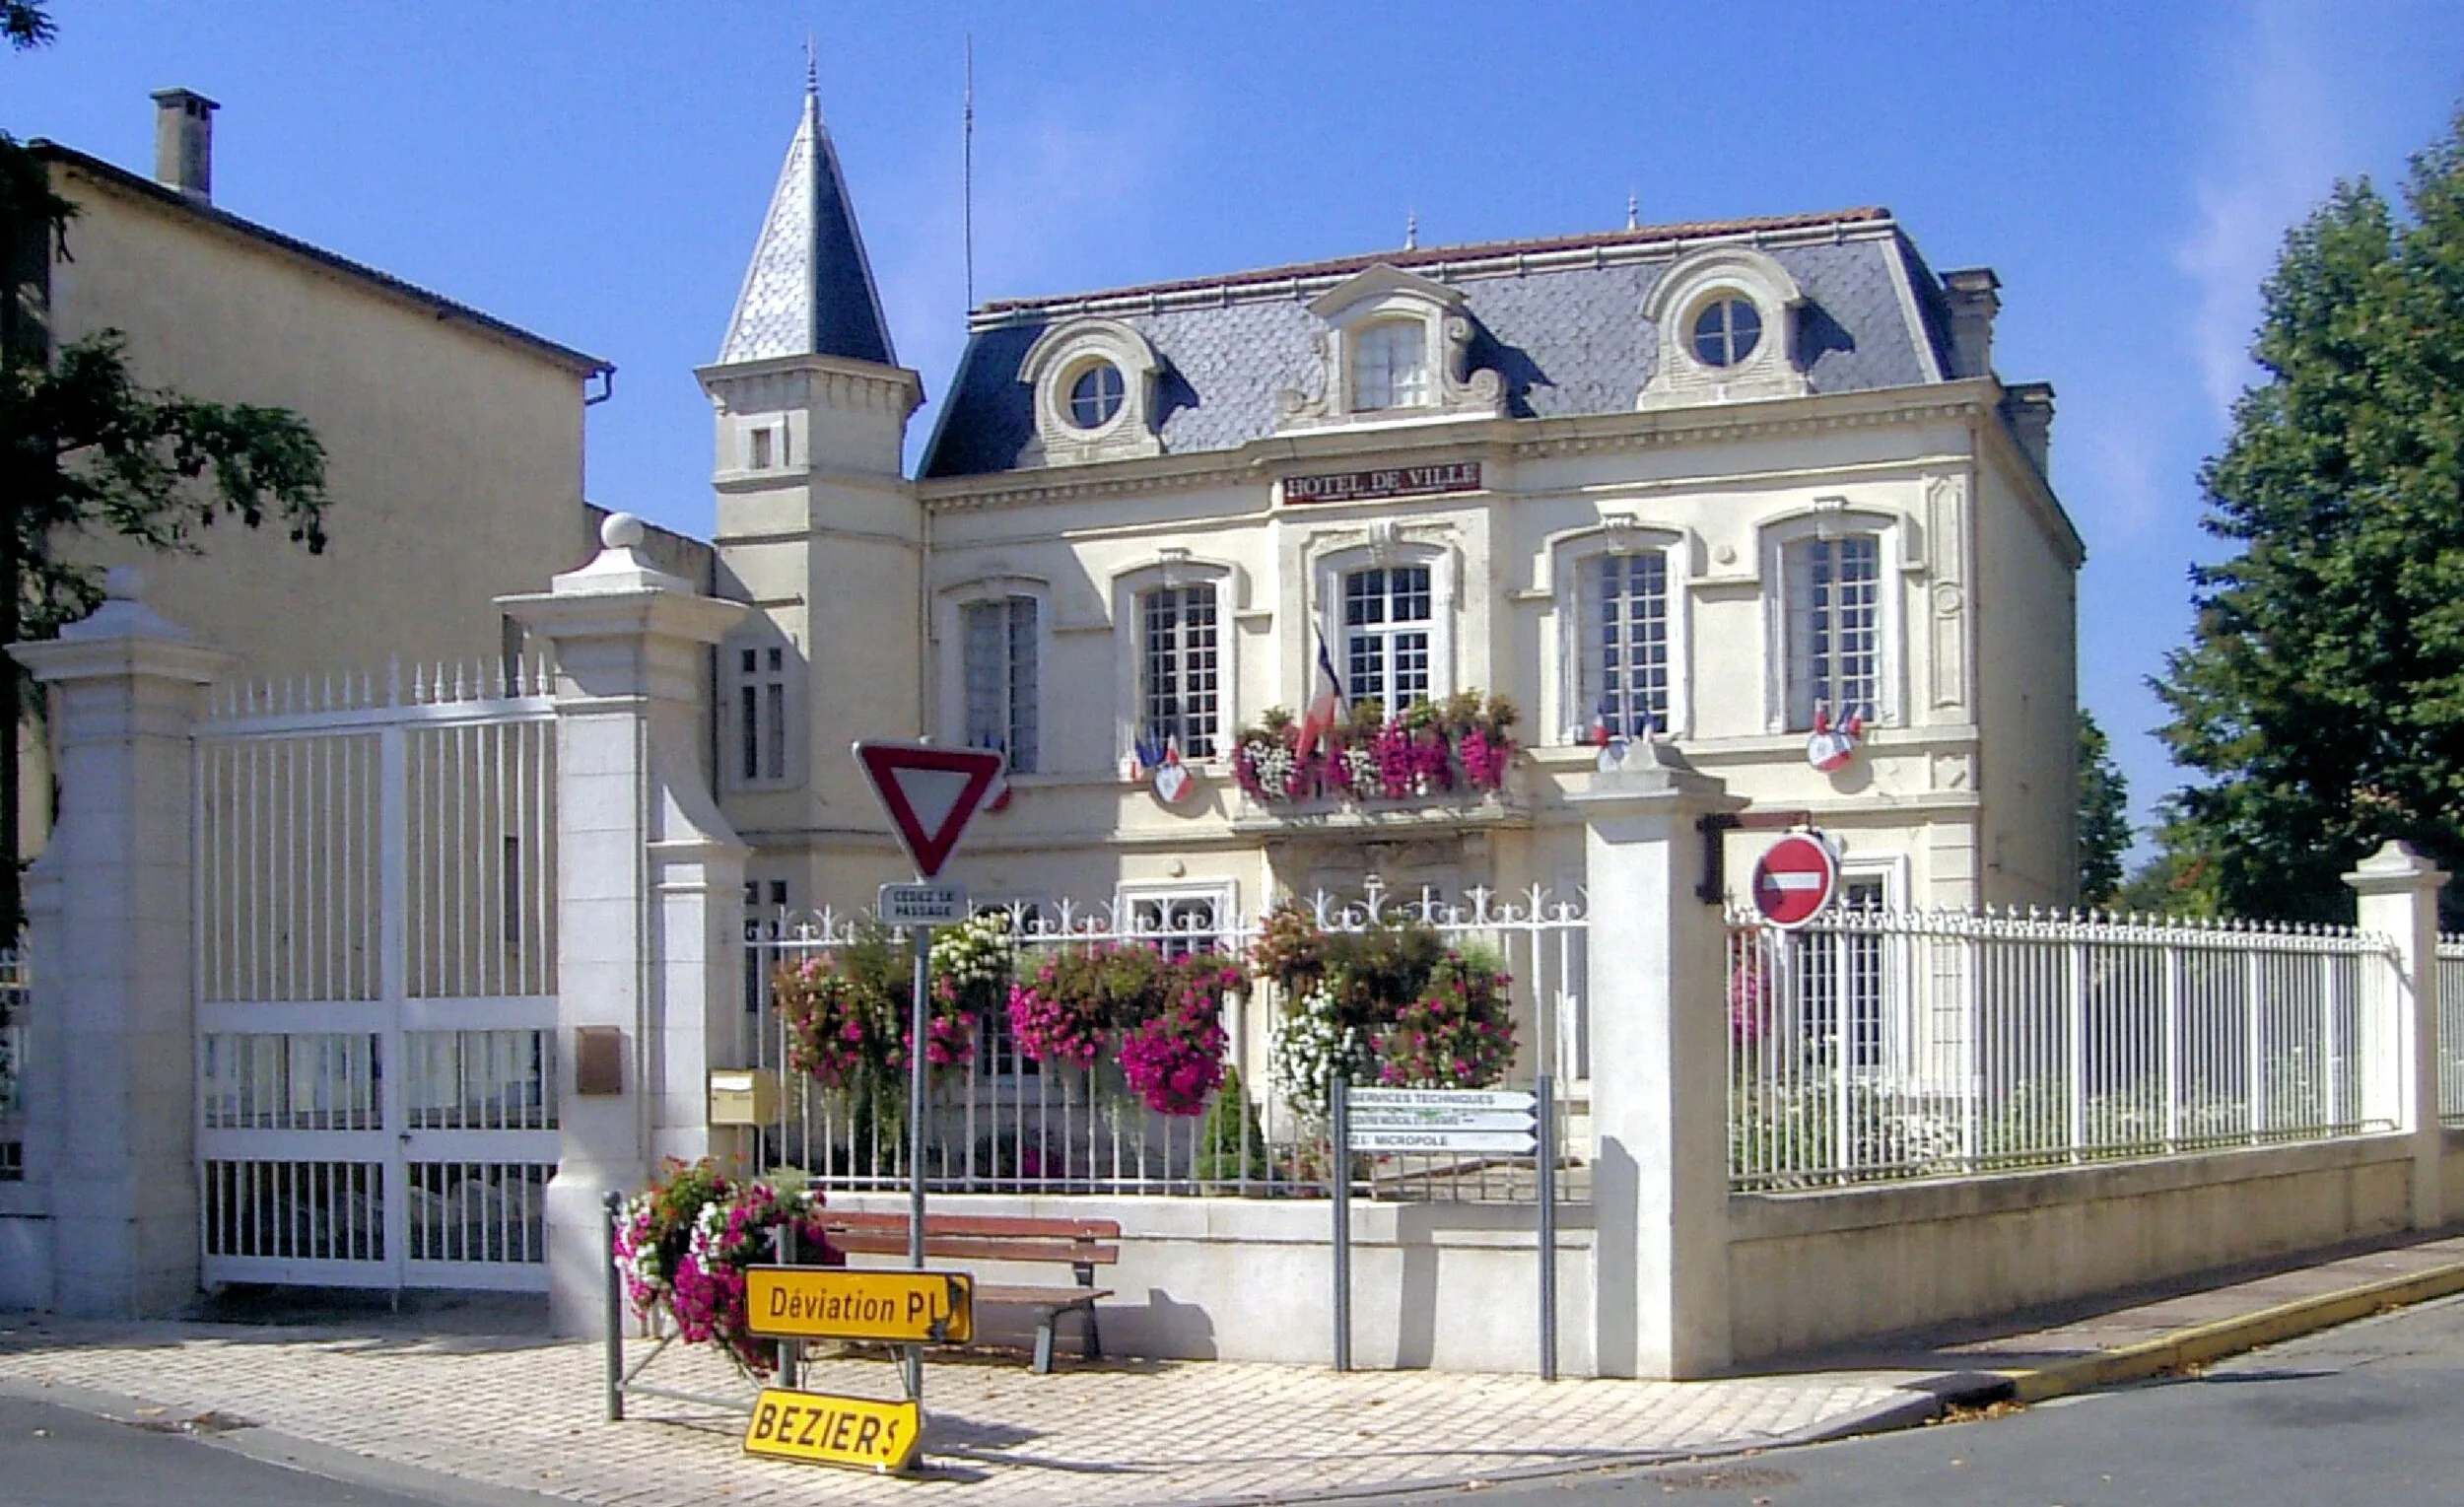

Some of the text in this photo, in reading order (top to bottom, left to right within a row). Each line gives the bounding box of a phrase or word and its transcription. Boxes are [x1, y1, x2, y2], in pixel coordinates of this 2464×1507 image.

[1287, 474, 1364, 497] HOTEL
[1371, 471, 1400, 490] DE
[1408, 463, 1477, 486] VILLE
[770, 1285, 895, 1322] Déviation
[753, 1403, 900, 1457] BEZIERS
